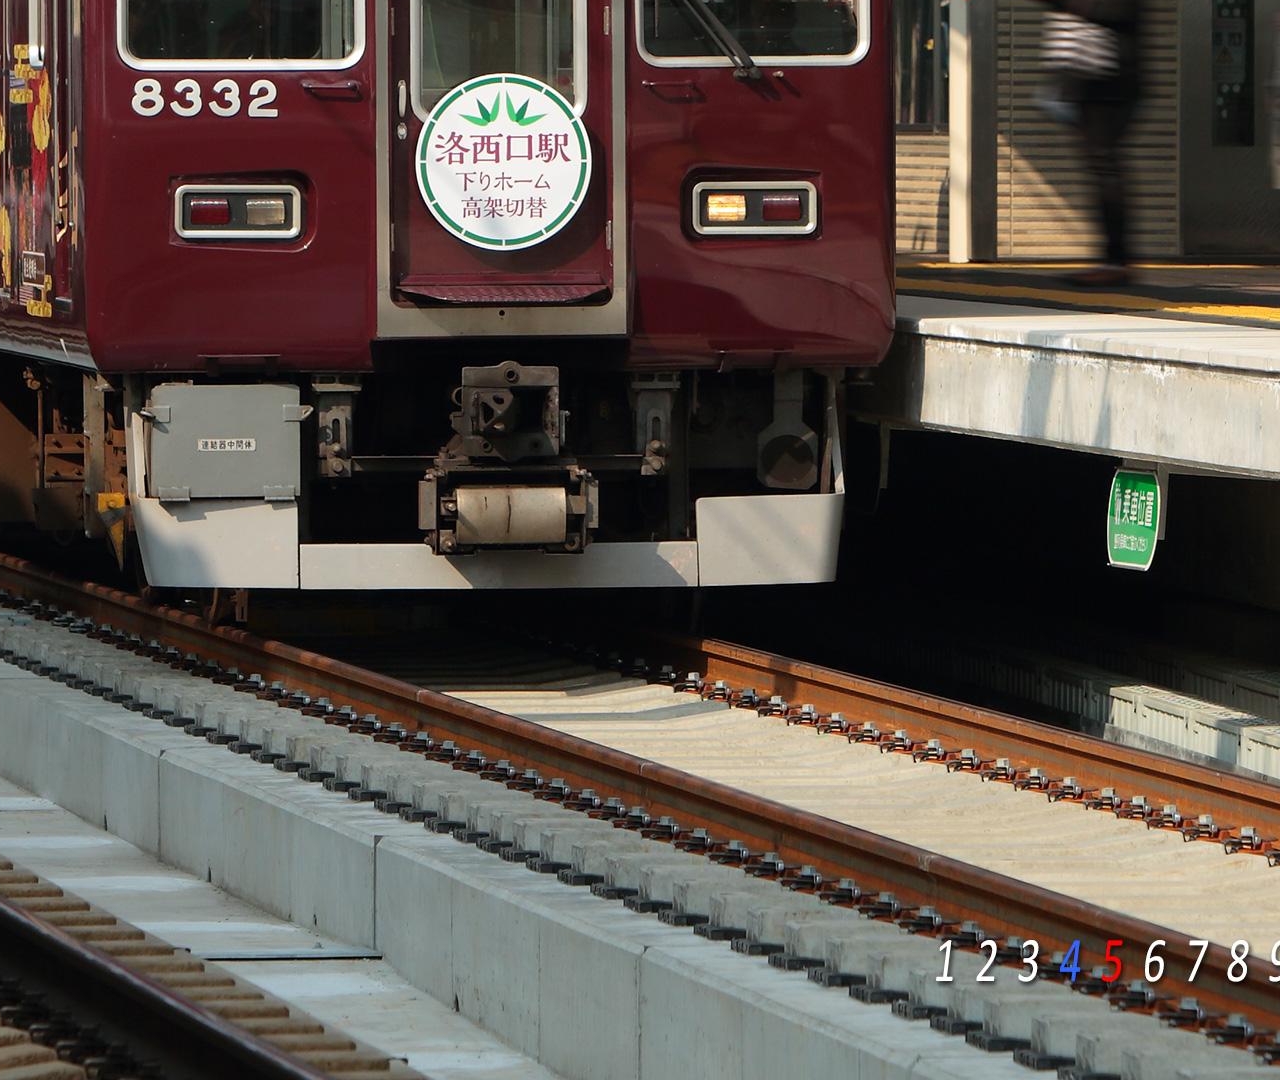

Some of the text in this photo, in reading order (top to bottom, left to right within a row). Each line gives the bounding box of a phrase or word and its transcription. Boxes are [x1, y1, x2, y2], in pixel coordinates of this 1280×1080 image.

[131, 78, 279, 117] 8332
[435, 131, 572, 165] 洛西口駅
[455, 171, 551, 192] 下りホーム
[461, 196, 548, 218] 高架切替
